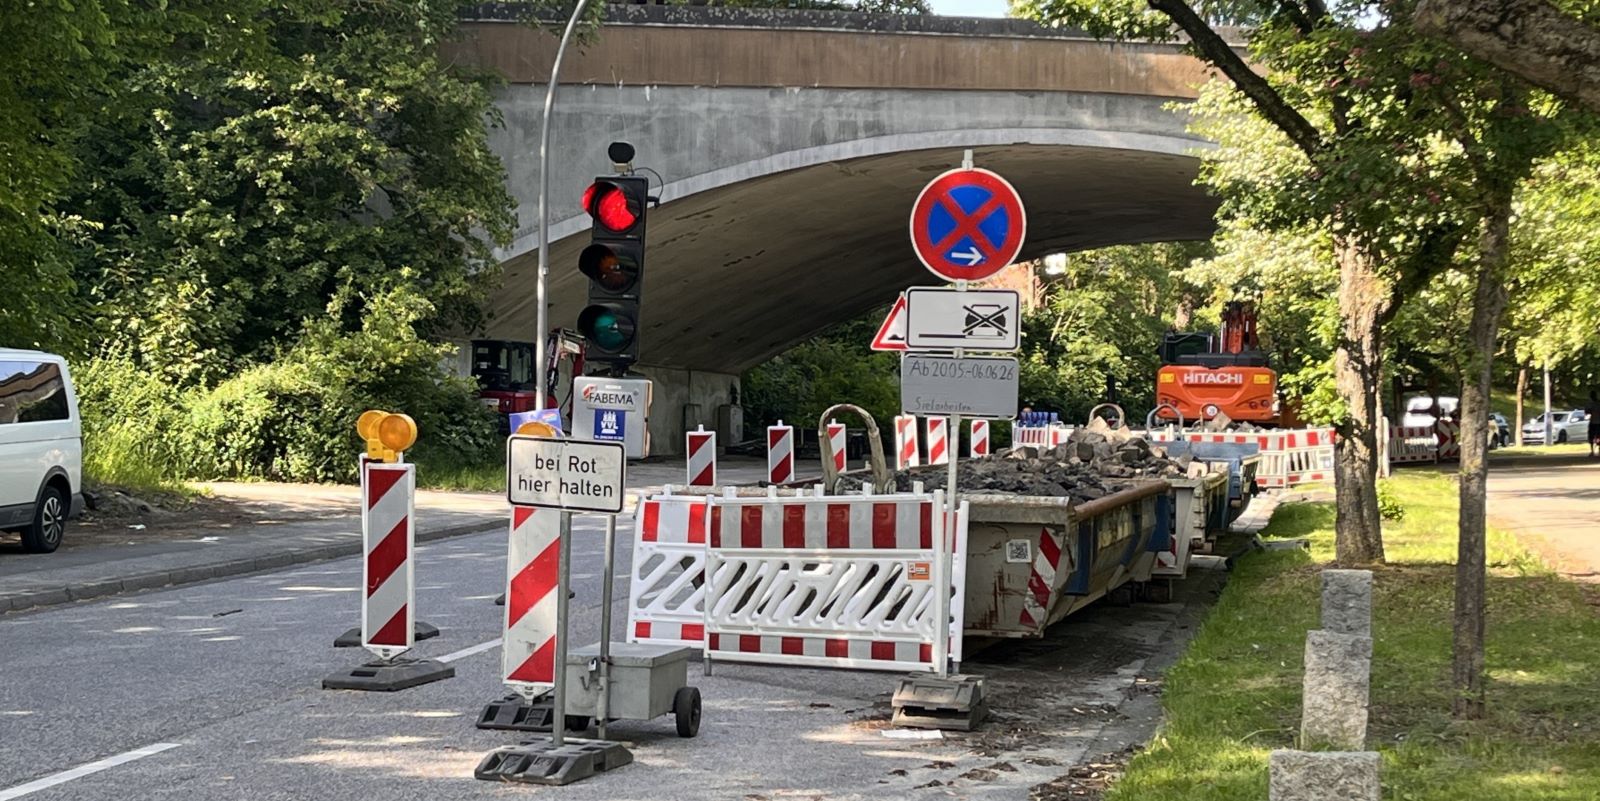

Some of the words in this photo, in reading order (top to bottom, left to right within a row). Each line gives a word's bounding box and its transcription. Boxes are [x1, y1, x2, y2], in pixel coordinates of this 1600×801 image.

[909, 360, 929, 377] Ab
[1184, 373, 1243, 385] HITACHI
[589, 392, 634, 405] FABEMA
[535, 453, 560, 470] bei
[568, 455, 597, 474] Rot
[518, 474, 552, 492] hier
[559, 477, 613, 498] halten
